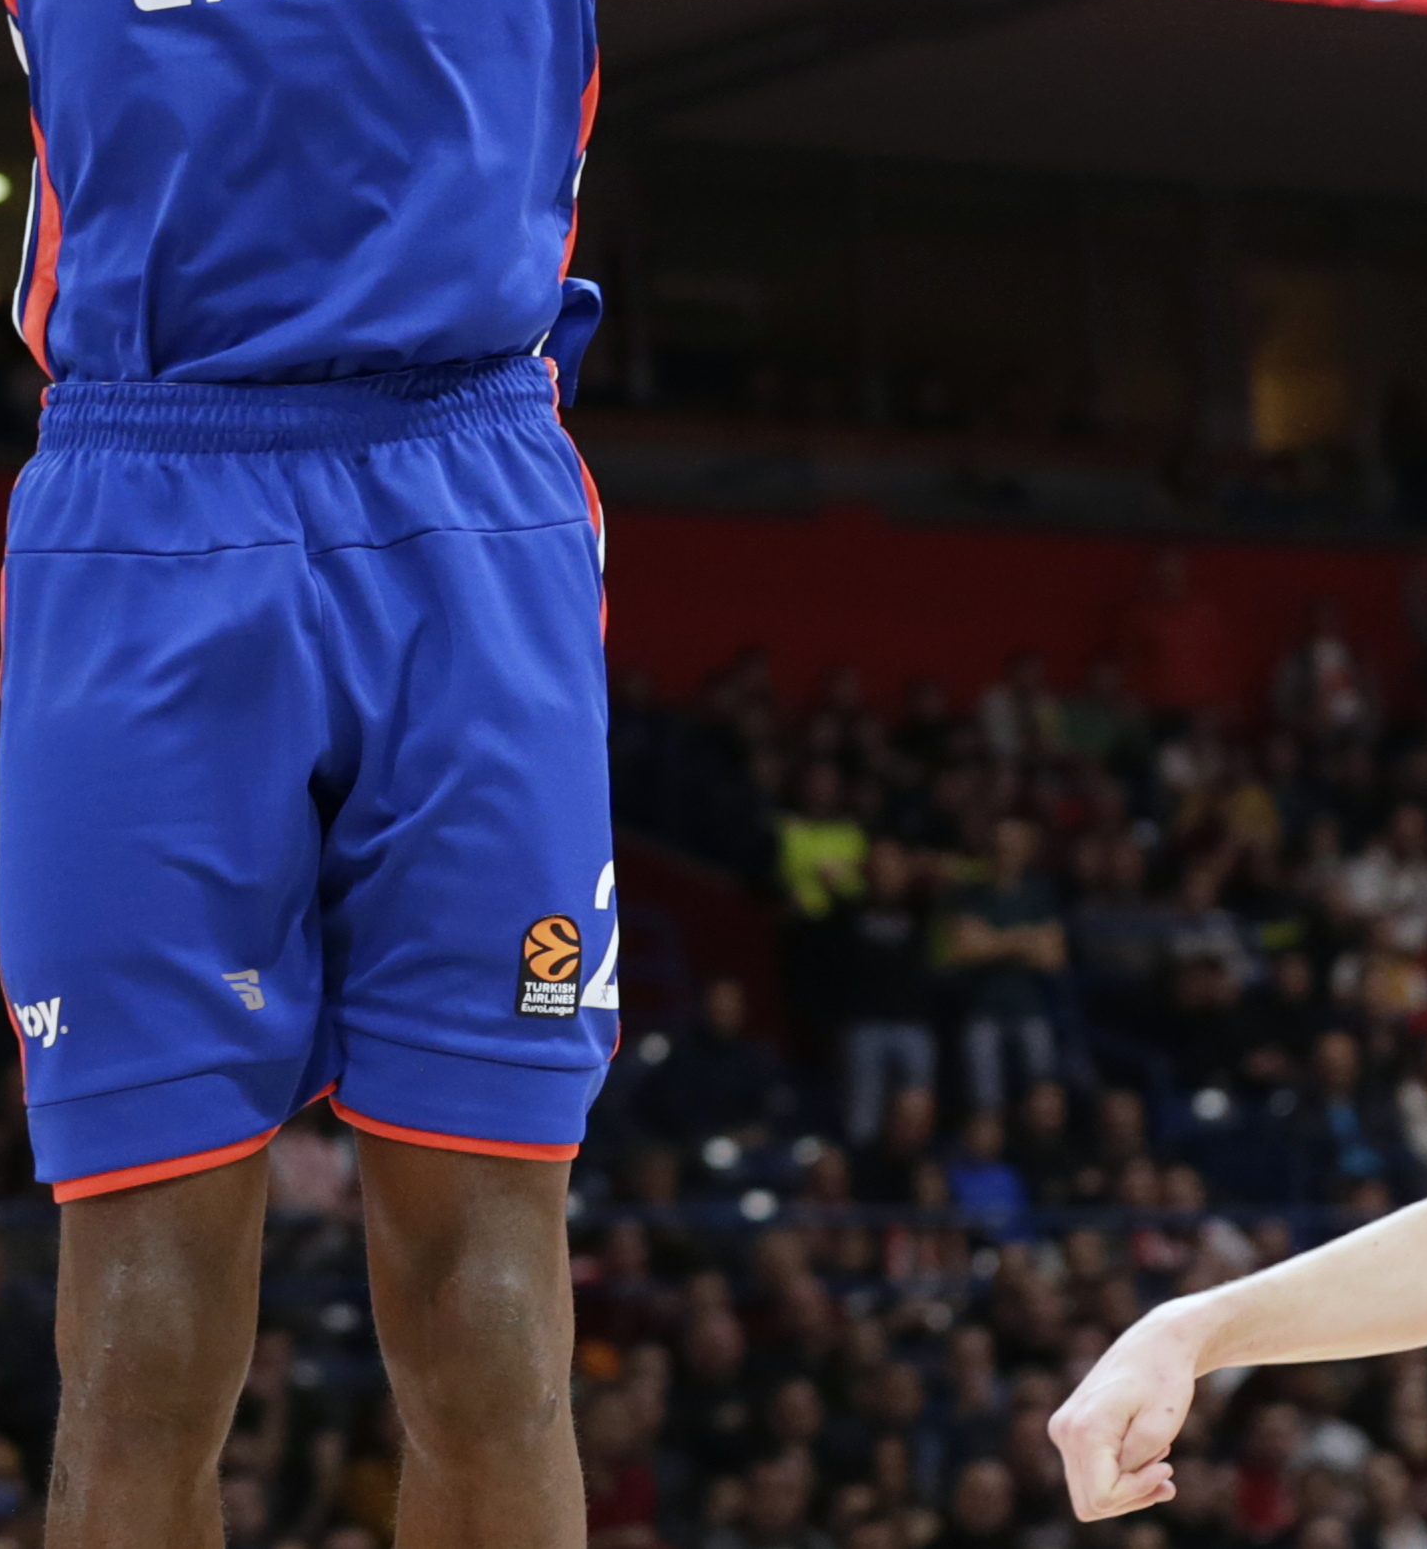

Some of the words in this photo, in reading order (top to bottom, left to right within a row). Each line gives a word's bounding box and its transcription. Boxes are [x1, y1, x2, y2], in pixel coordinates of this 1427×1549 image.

[525, 981, 576, 994] TURKISH
[522, 993, 575, 1004] AIRLINES
[521, 1003, 575, 1016] EuroLeague
